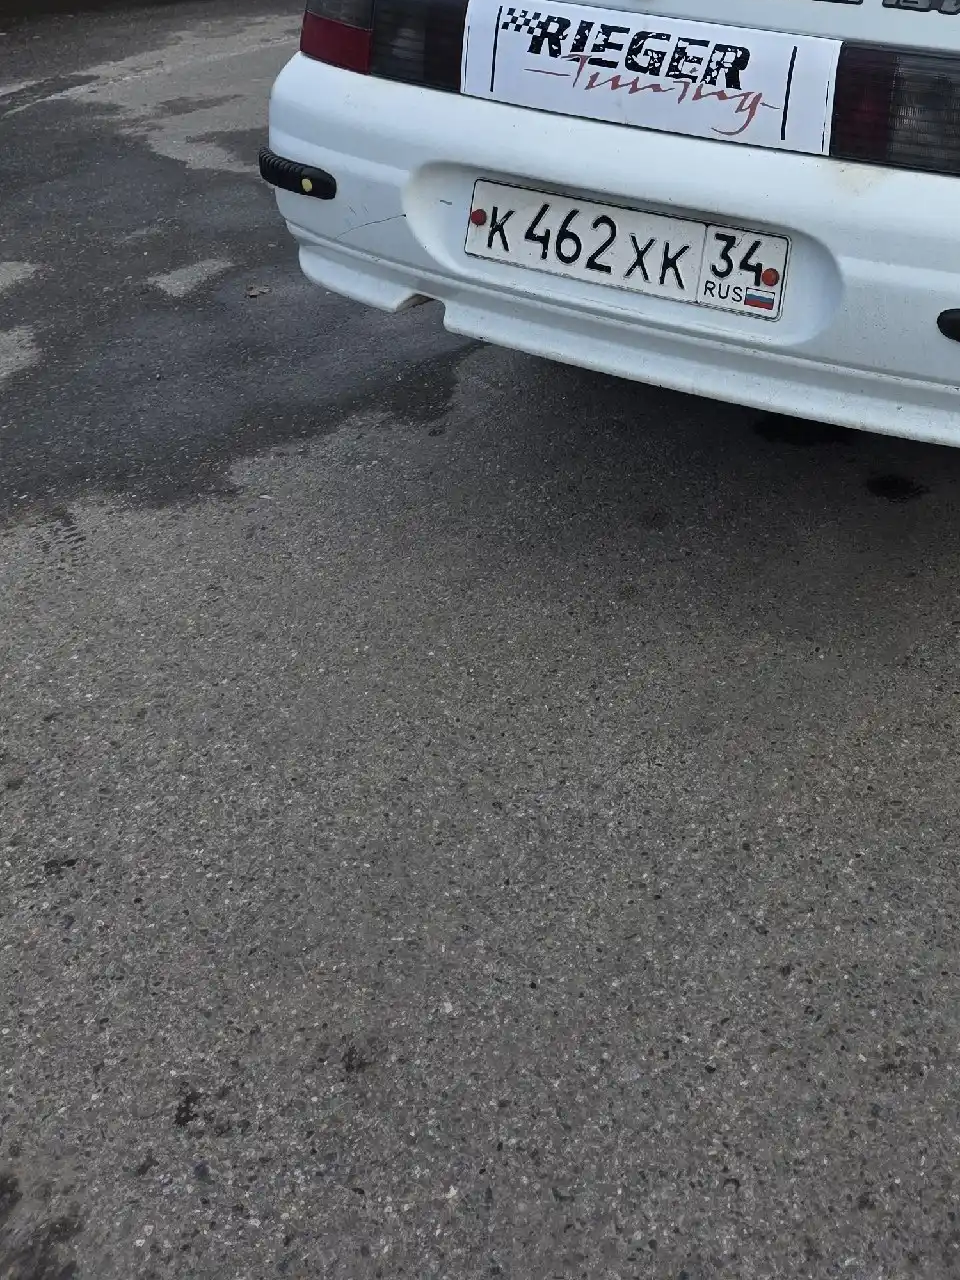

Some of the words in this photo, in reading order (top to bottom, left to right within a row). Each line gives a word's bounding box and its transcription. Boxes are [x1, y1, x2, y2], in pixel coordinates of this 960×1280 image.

[527, 14, 751, 91] RIEGER
[711, 233, 763, 287] 34
[703, 280, 743, 302] RUS
